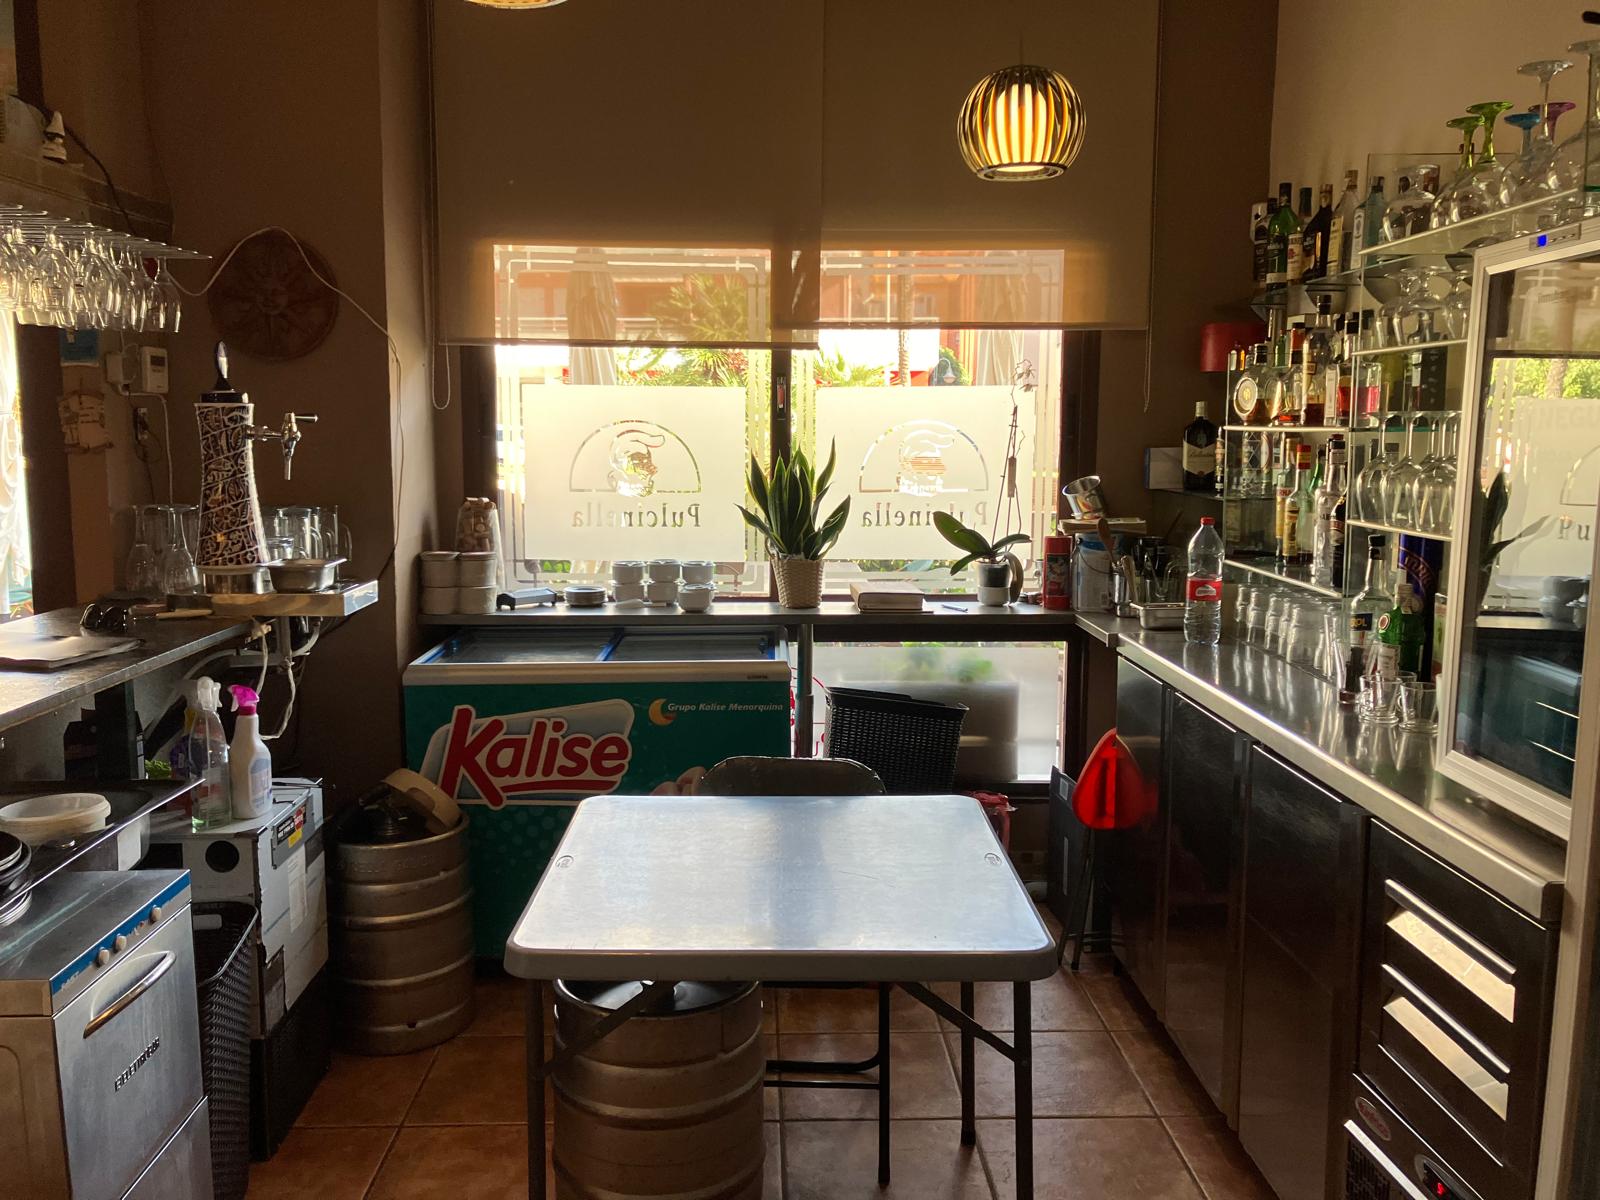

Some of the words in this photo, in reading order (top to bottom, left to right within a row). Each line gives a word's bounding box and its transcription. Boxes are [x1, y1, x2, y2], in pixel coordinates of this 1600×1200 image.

[667, 703, 697, 712] Grupo
[699, 703, 726, 711] Kalise
[728, 703, 784, 713] Menorquina
[440, 707, 630, 807] Kalise
